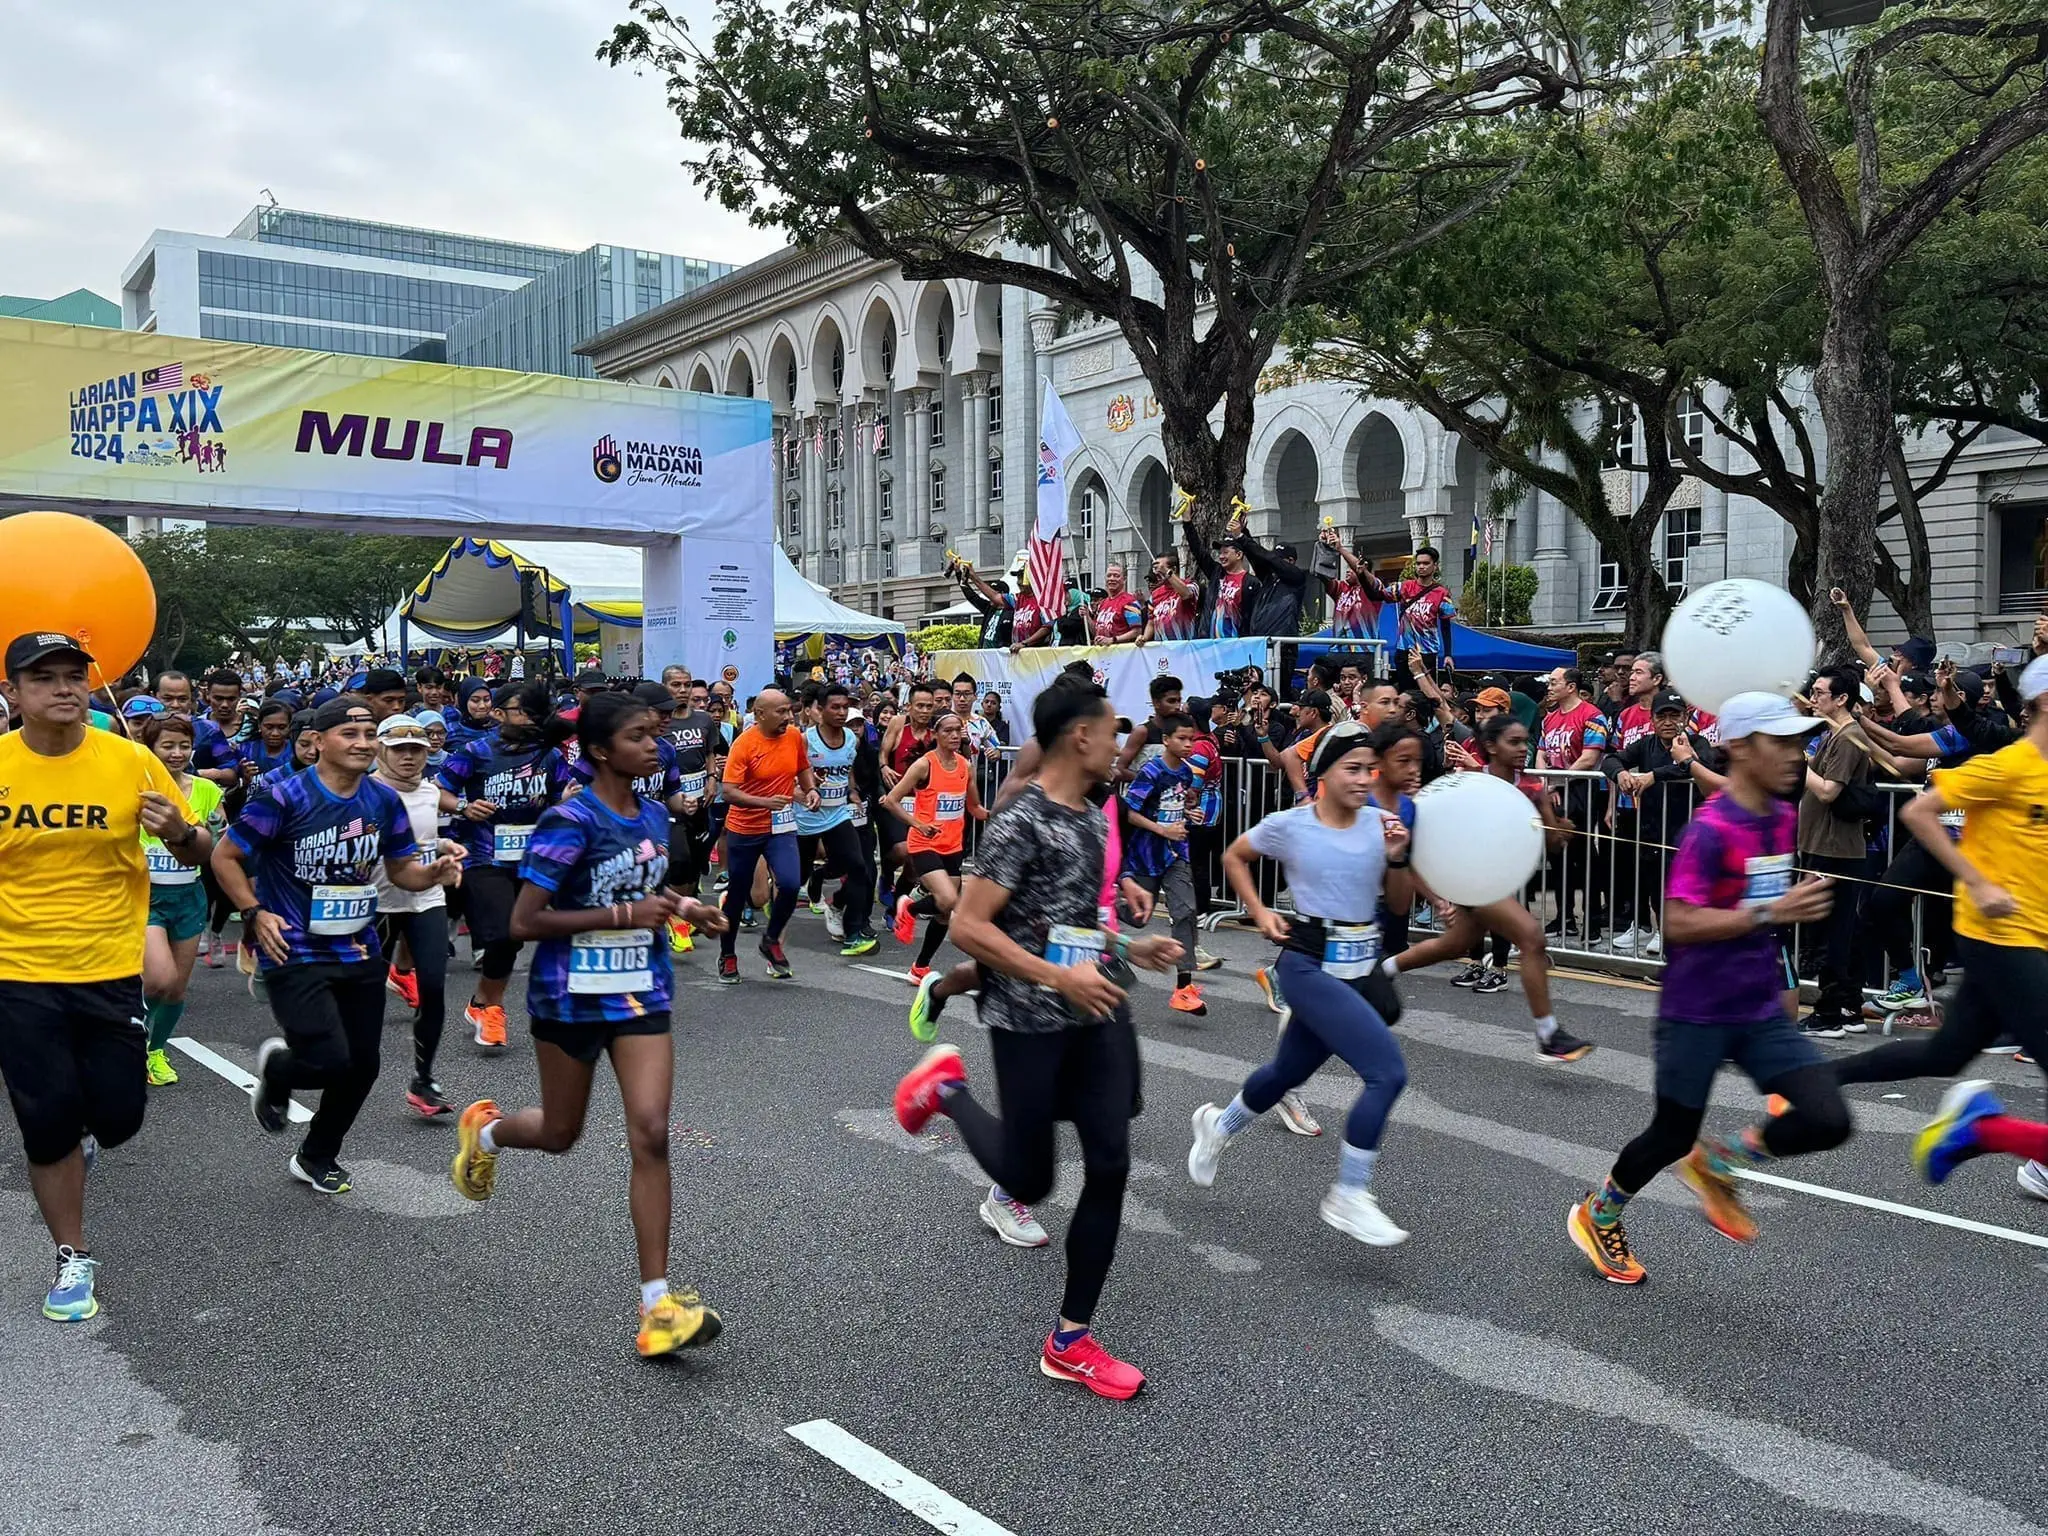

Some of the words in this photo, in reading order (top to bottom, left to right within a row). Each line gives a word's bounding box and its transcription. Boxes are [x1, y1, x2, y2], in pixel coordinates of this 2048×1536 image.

[70, 372, 136, 408] LARIAN
[70, 396, 162, 432] MAPPA
[168, 385, 224, 433] XIX
[70, 433, 125, 464] 2024
[294, 409, 514, 469] MULA
[626, 441, 702, 460] MALAYSIA
[626, 453, 703, 475] MADANI
[671, 728, 702, 741] YOU
[484, 780, 524, 797] MAPPA
[526, 773, 548, 796] XIX
[294, 826, 338, 851] LARIAN
[294, 841, 349, 866] MAPPA
[350, 829, 380, 864] XIX
[503, 836, 527, 849] 231
[294, 864, 328, 884] 2024
[322, 900, 370, 919] 2103
[576, 946, 650, 972] 11003
